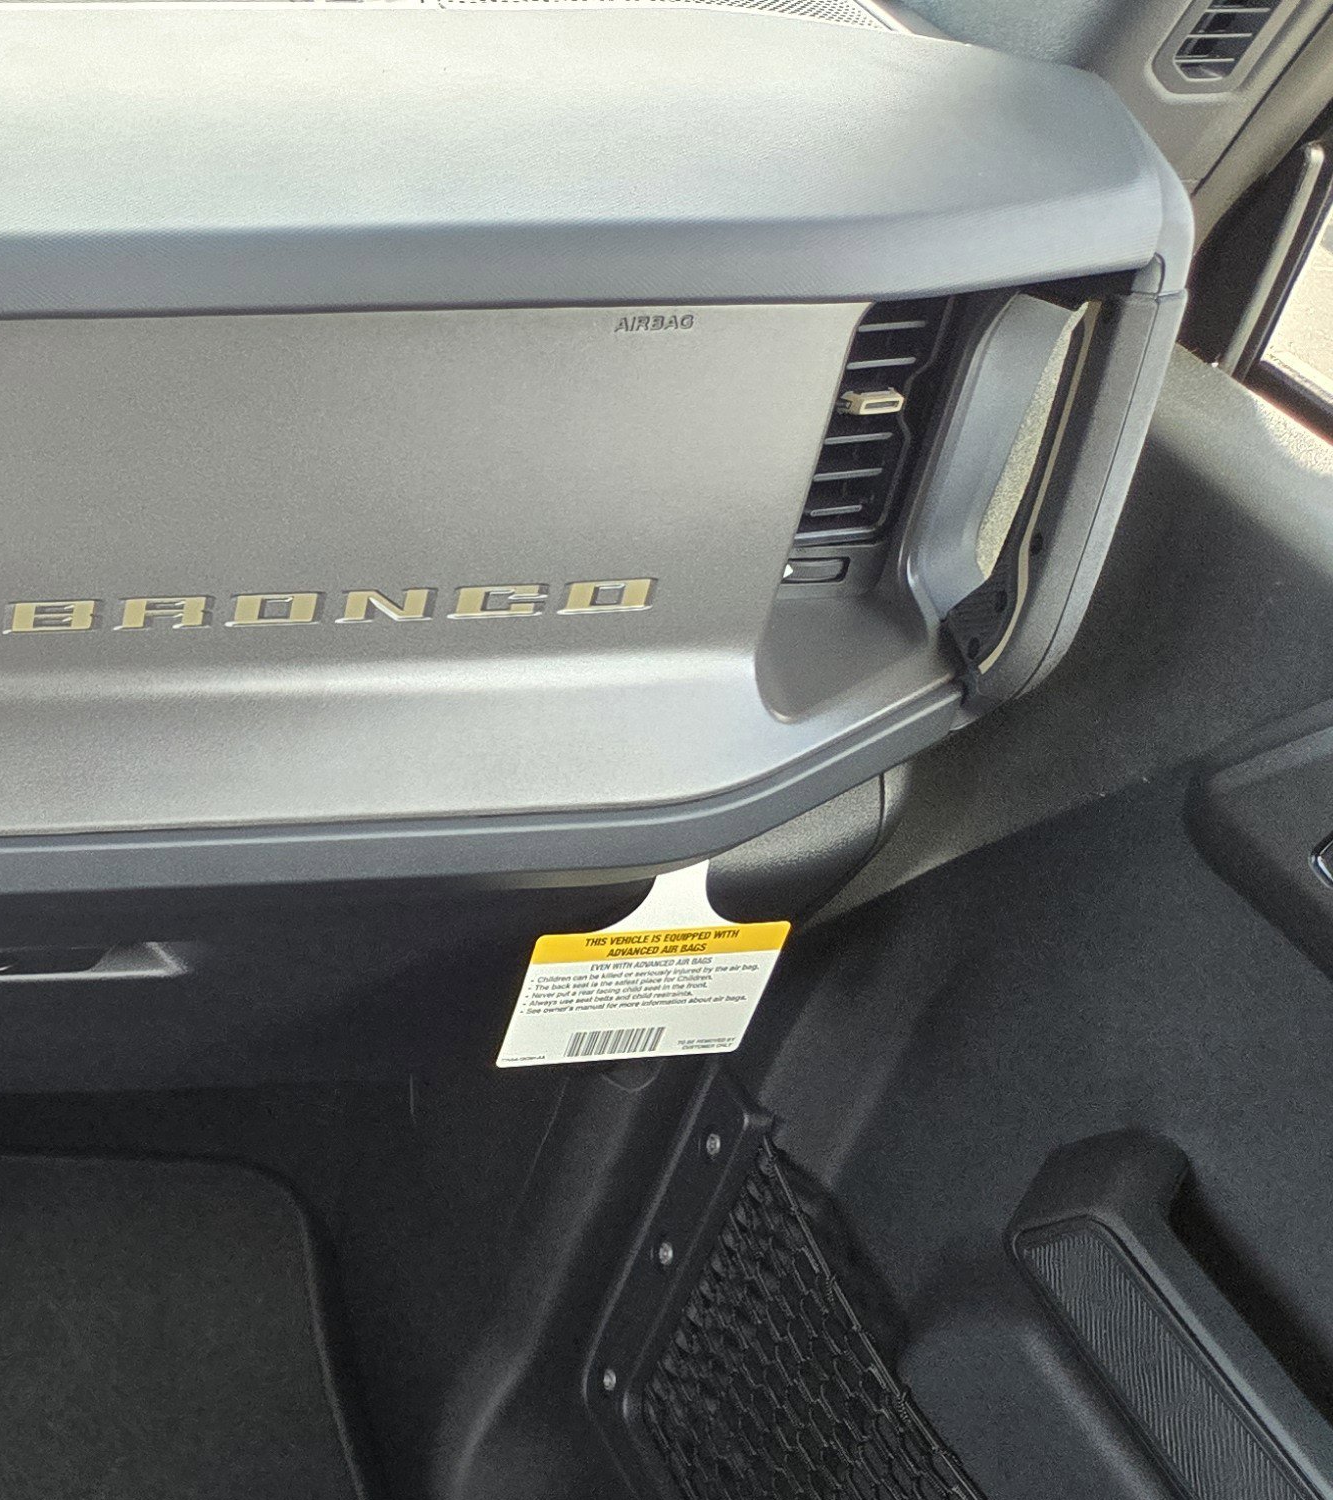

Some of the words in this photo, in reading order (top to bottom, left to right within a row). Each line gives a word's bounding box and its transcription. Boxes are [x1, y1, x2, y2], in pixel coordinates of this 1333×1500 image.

[614, 314, 694, 333] AIRBAG
[3, 576, 659, 636] BRONCO
[585, 938, 608, 947] THIS
[610, 935, 650, 946] VEHICLE
[651, 934, 661, 943] IS
[663, 932, 711, 942] EQUIPPED
[713, 930, 740, 939] WITH
[607, 946, 660, 957] ADVANCED
[660, 945, 679, 954] AIR
[681, 944, 707, 953] BAGS
[591, 963, 611, 972] EVEN
[613, 962, 633, 970] WITH
[634, 959, 675, 968] ADVANCED
[675, 958, 690, 966] AIR
[691, 957, 713, 965] BAGS
[537, 976, 571, 984] Children
[601, 971, 623, 979] killed
[635, 968, 672, 977] seriously
[673, 968, 701, 976] injured
[551, 982, 570, 990] back
[639, 977, 663, 985] place
[529, 999, 558, 1007] Always
[632, 992, 653, 1000] child
[575, 1004, 605, 1012] manual
[641, 998, 687, 1007] information
[688, 996, 712, 1004] about
